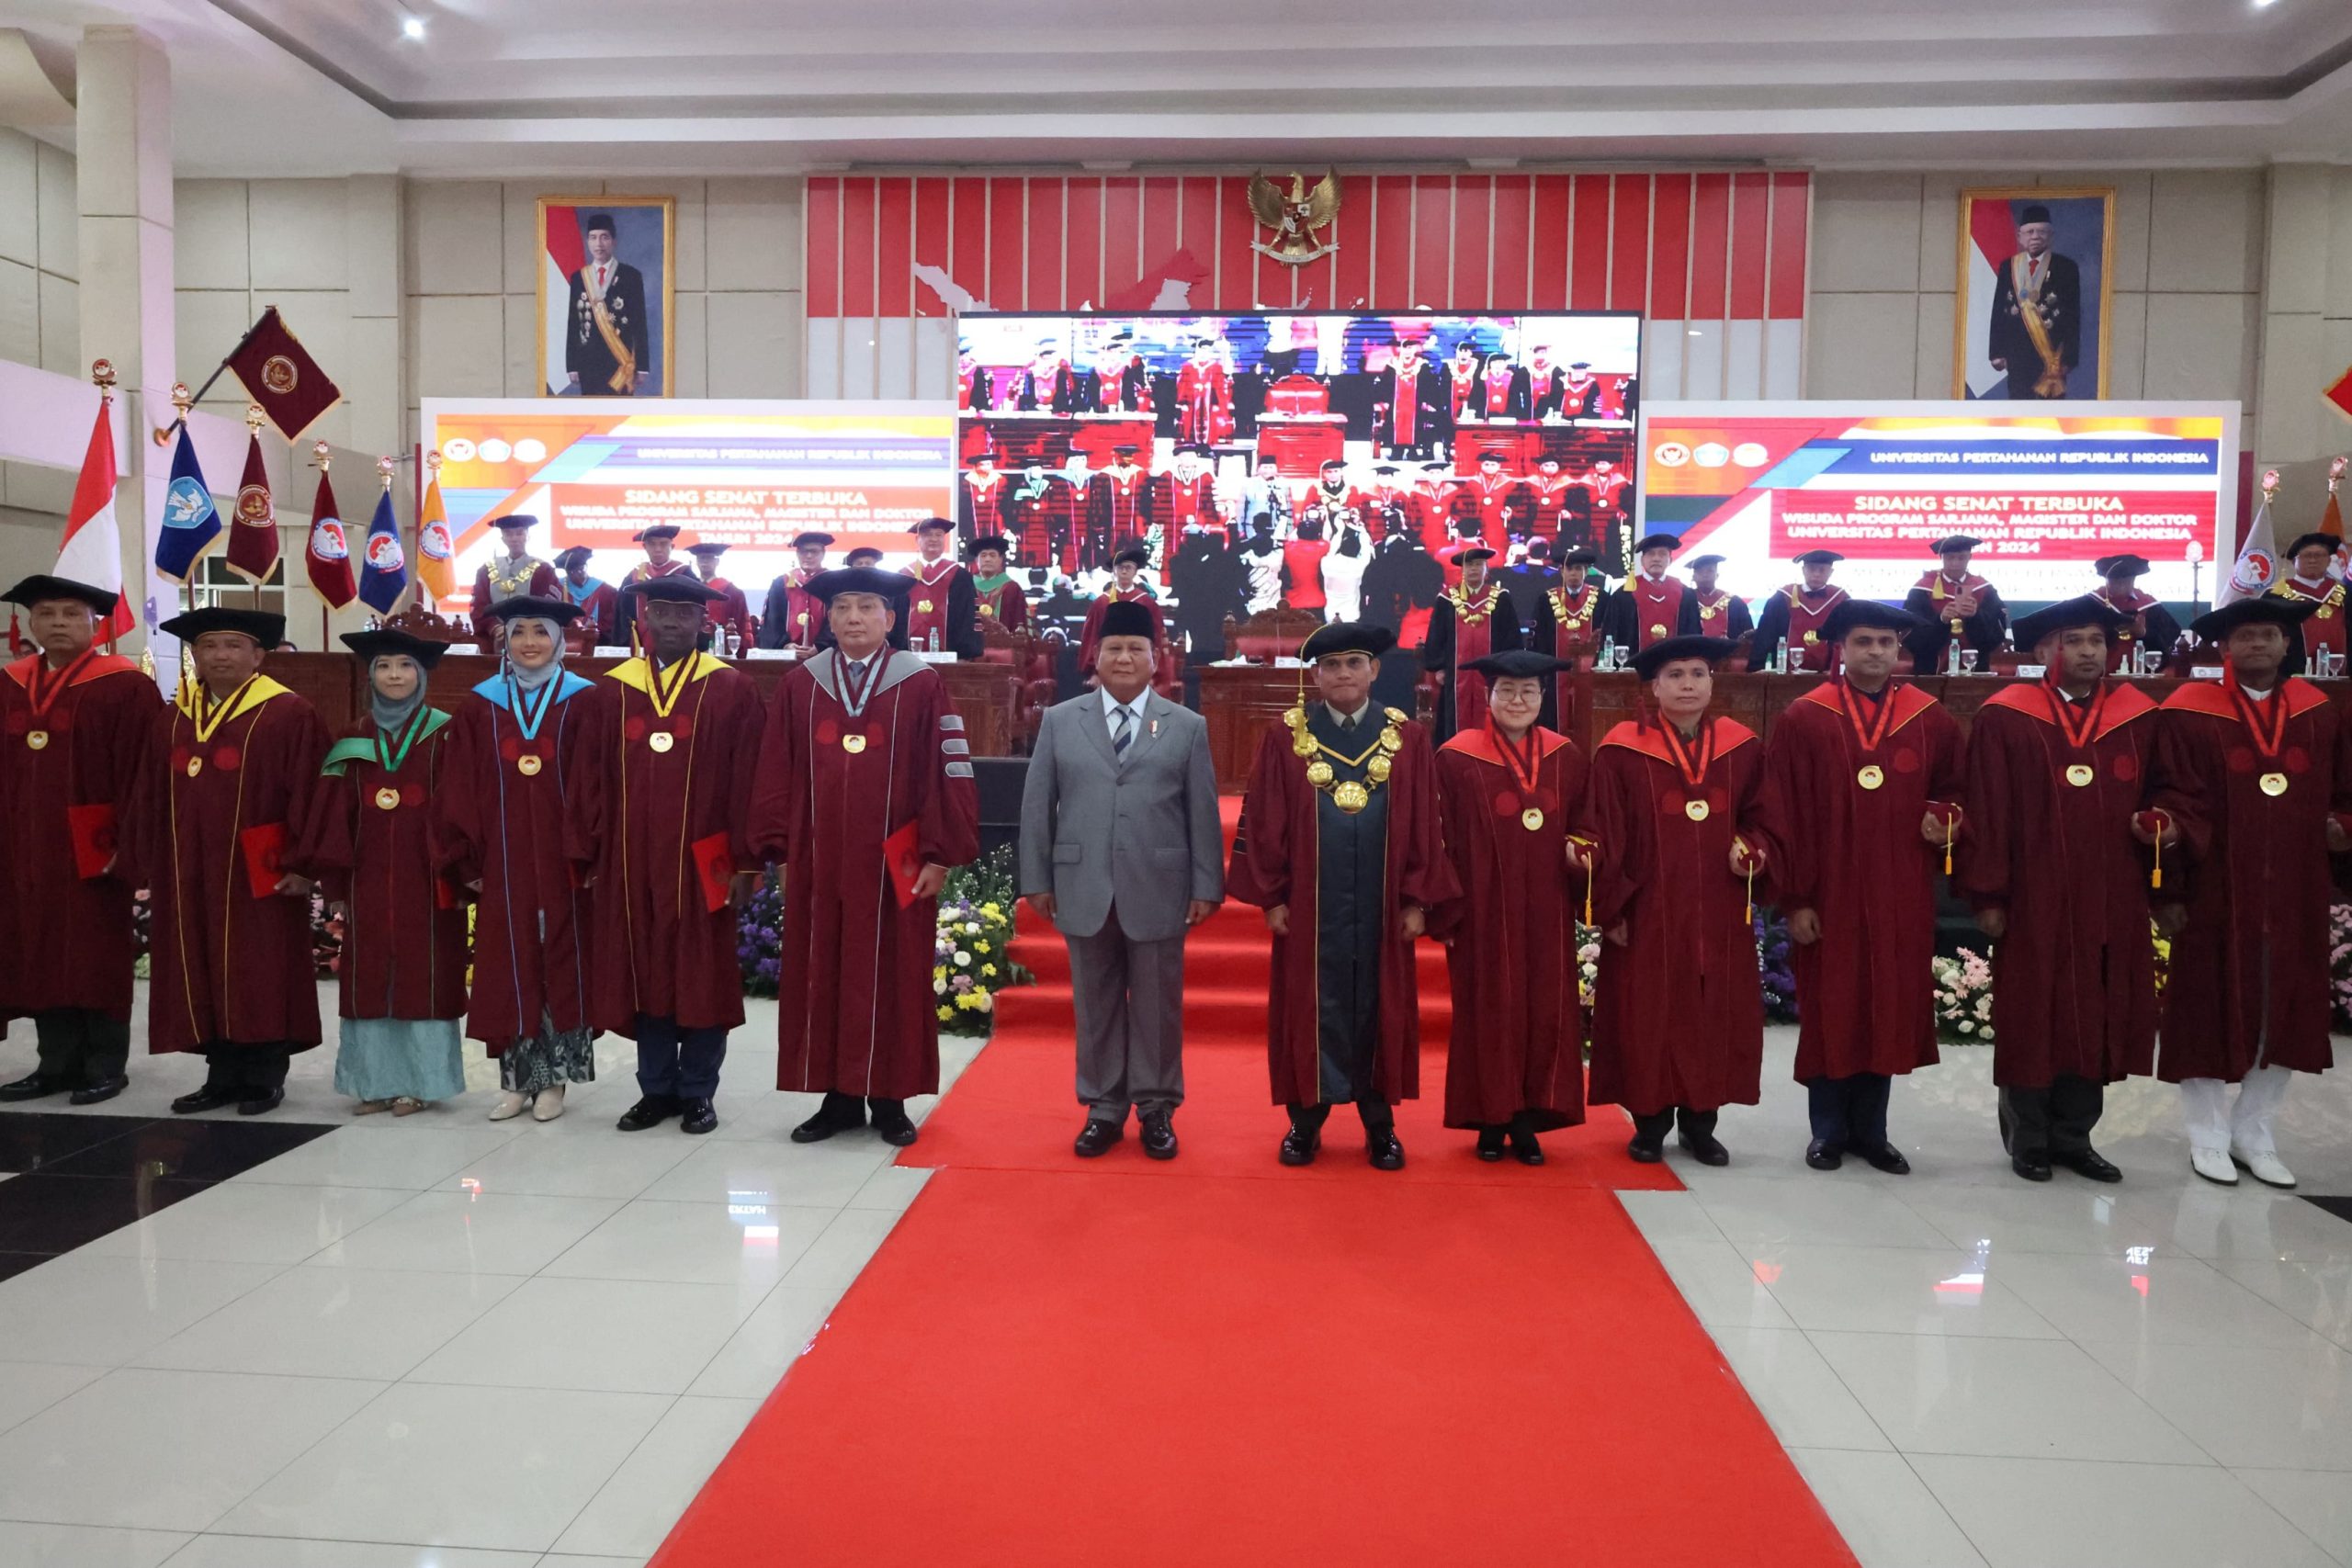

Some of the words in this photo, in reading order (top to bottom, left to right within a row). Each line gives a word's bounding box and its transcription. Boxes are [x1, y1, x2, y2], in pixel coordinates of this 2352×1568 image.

[1870, 452, 1960, 463] UNIVERSITAS
[1962, 452, 2056, 463] PERTAHANAN
[2060, 452, 2129, 463] REPUBLIK
[2132, 452, 2209, 463] INDONESIA
[625, 489, 699, 504] SIDANG
[704, 490, 768, 504] SENAT
[772, 491, 867, 505] TERBUKA
[1854, 496, 1937, 511] SIDANG
[1943, 496, 2014, 511] SENAT
[2018, 496, 2124, 511] TERBUKA
[839, 508, 870, 519] DAN
[873, 509, 933, 520] DOKTOR
[1782, 513, 1843, 524] WISUDA
[1847, 513, 1924, 525] PROGRAM
[1928, 513, 2005, 526] SARJANA,
[2009, 513, 2088, 525] MAGISTER
[2093, 514, 2127, 525] DAN
[2131, 514, 2198, 525] DOKTOR
[697, 532, 751, 544] TAHUN
[1788, 526, 1893, 538] UNIVERSITAS
[1897, 526, 2009, 539] PERTAHANAN
[2014, 527, 2097, 539] REPUBLIK
[2100, 527, 2192, 539] INDONESIA
[1996, 541, 2041, 553] 2024
